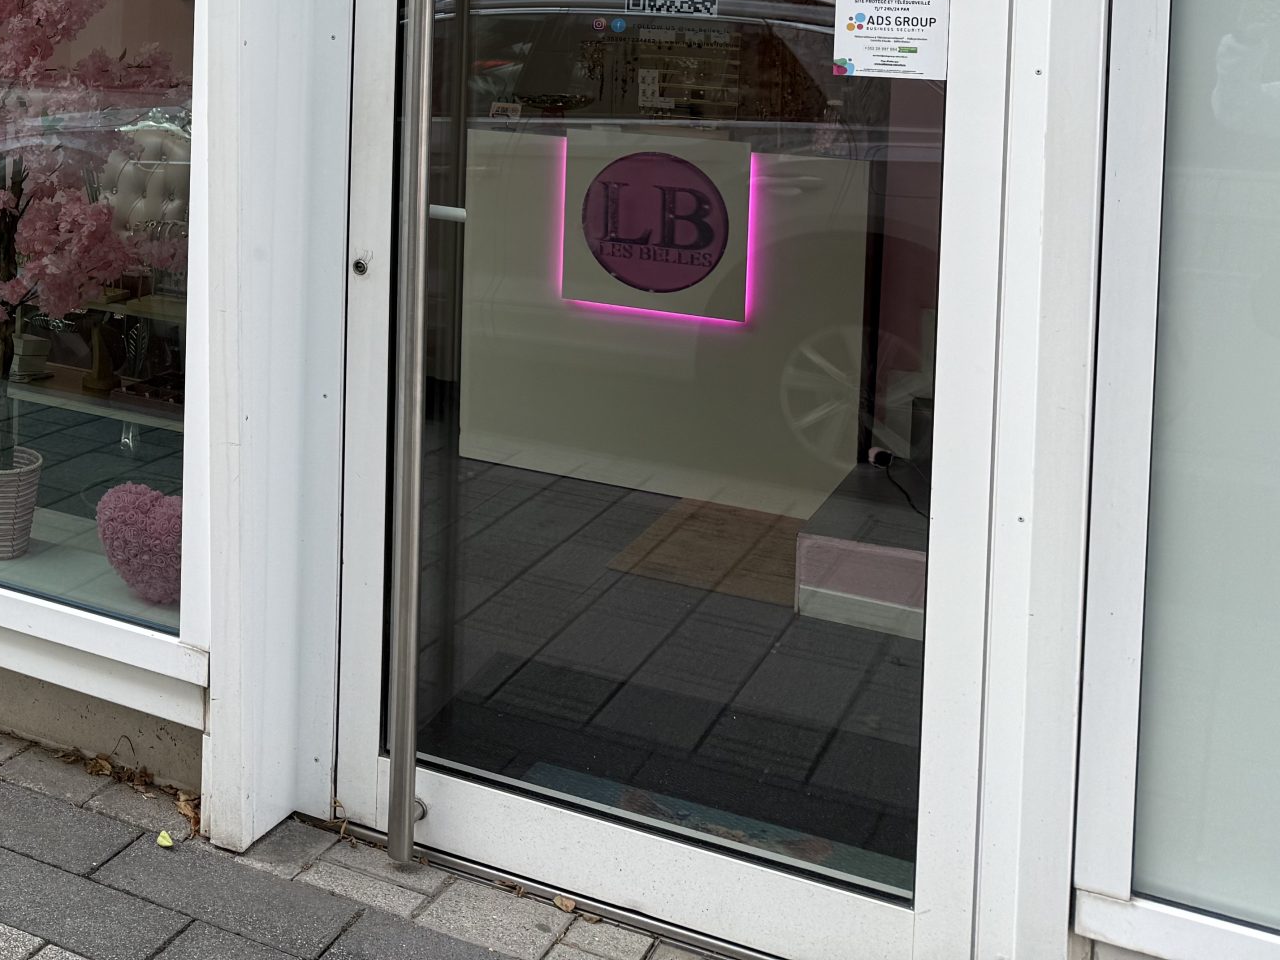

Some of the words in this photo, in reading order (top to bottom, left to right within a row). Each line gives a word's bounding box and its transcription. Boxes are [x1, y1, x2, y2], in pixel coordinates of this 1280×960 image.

[866, 15, 892, 26] ADS
[894, 16, 937, 27] GROUP
[596, 181, 716, 251] LB
[598, 241, 634, 259] LES
[639, 248, 714, 268] BELLES
